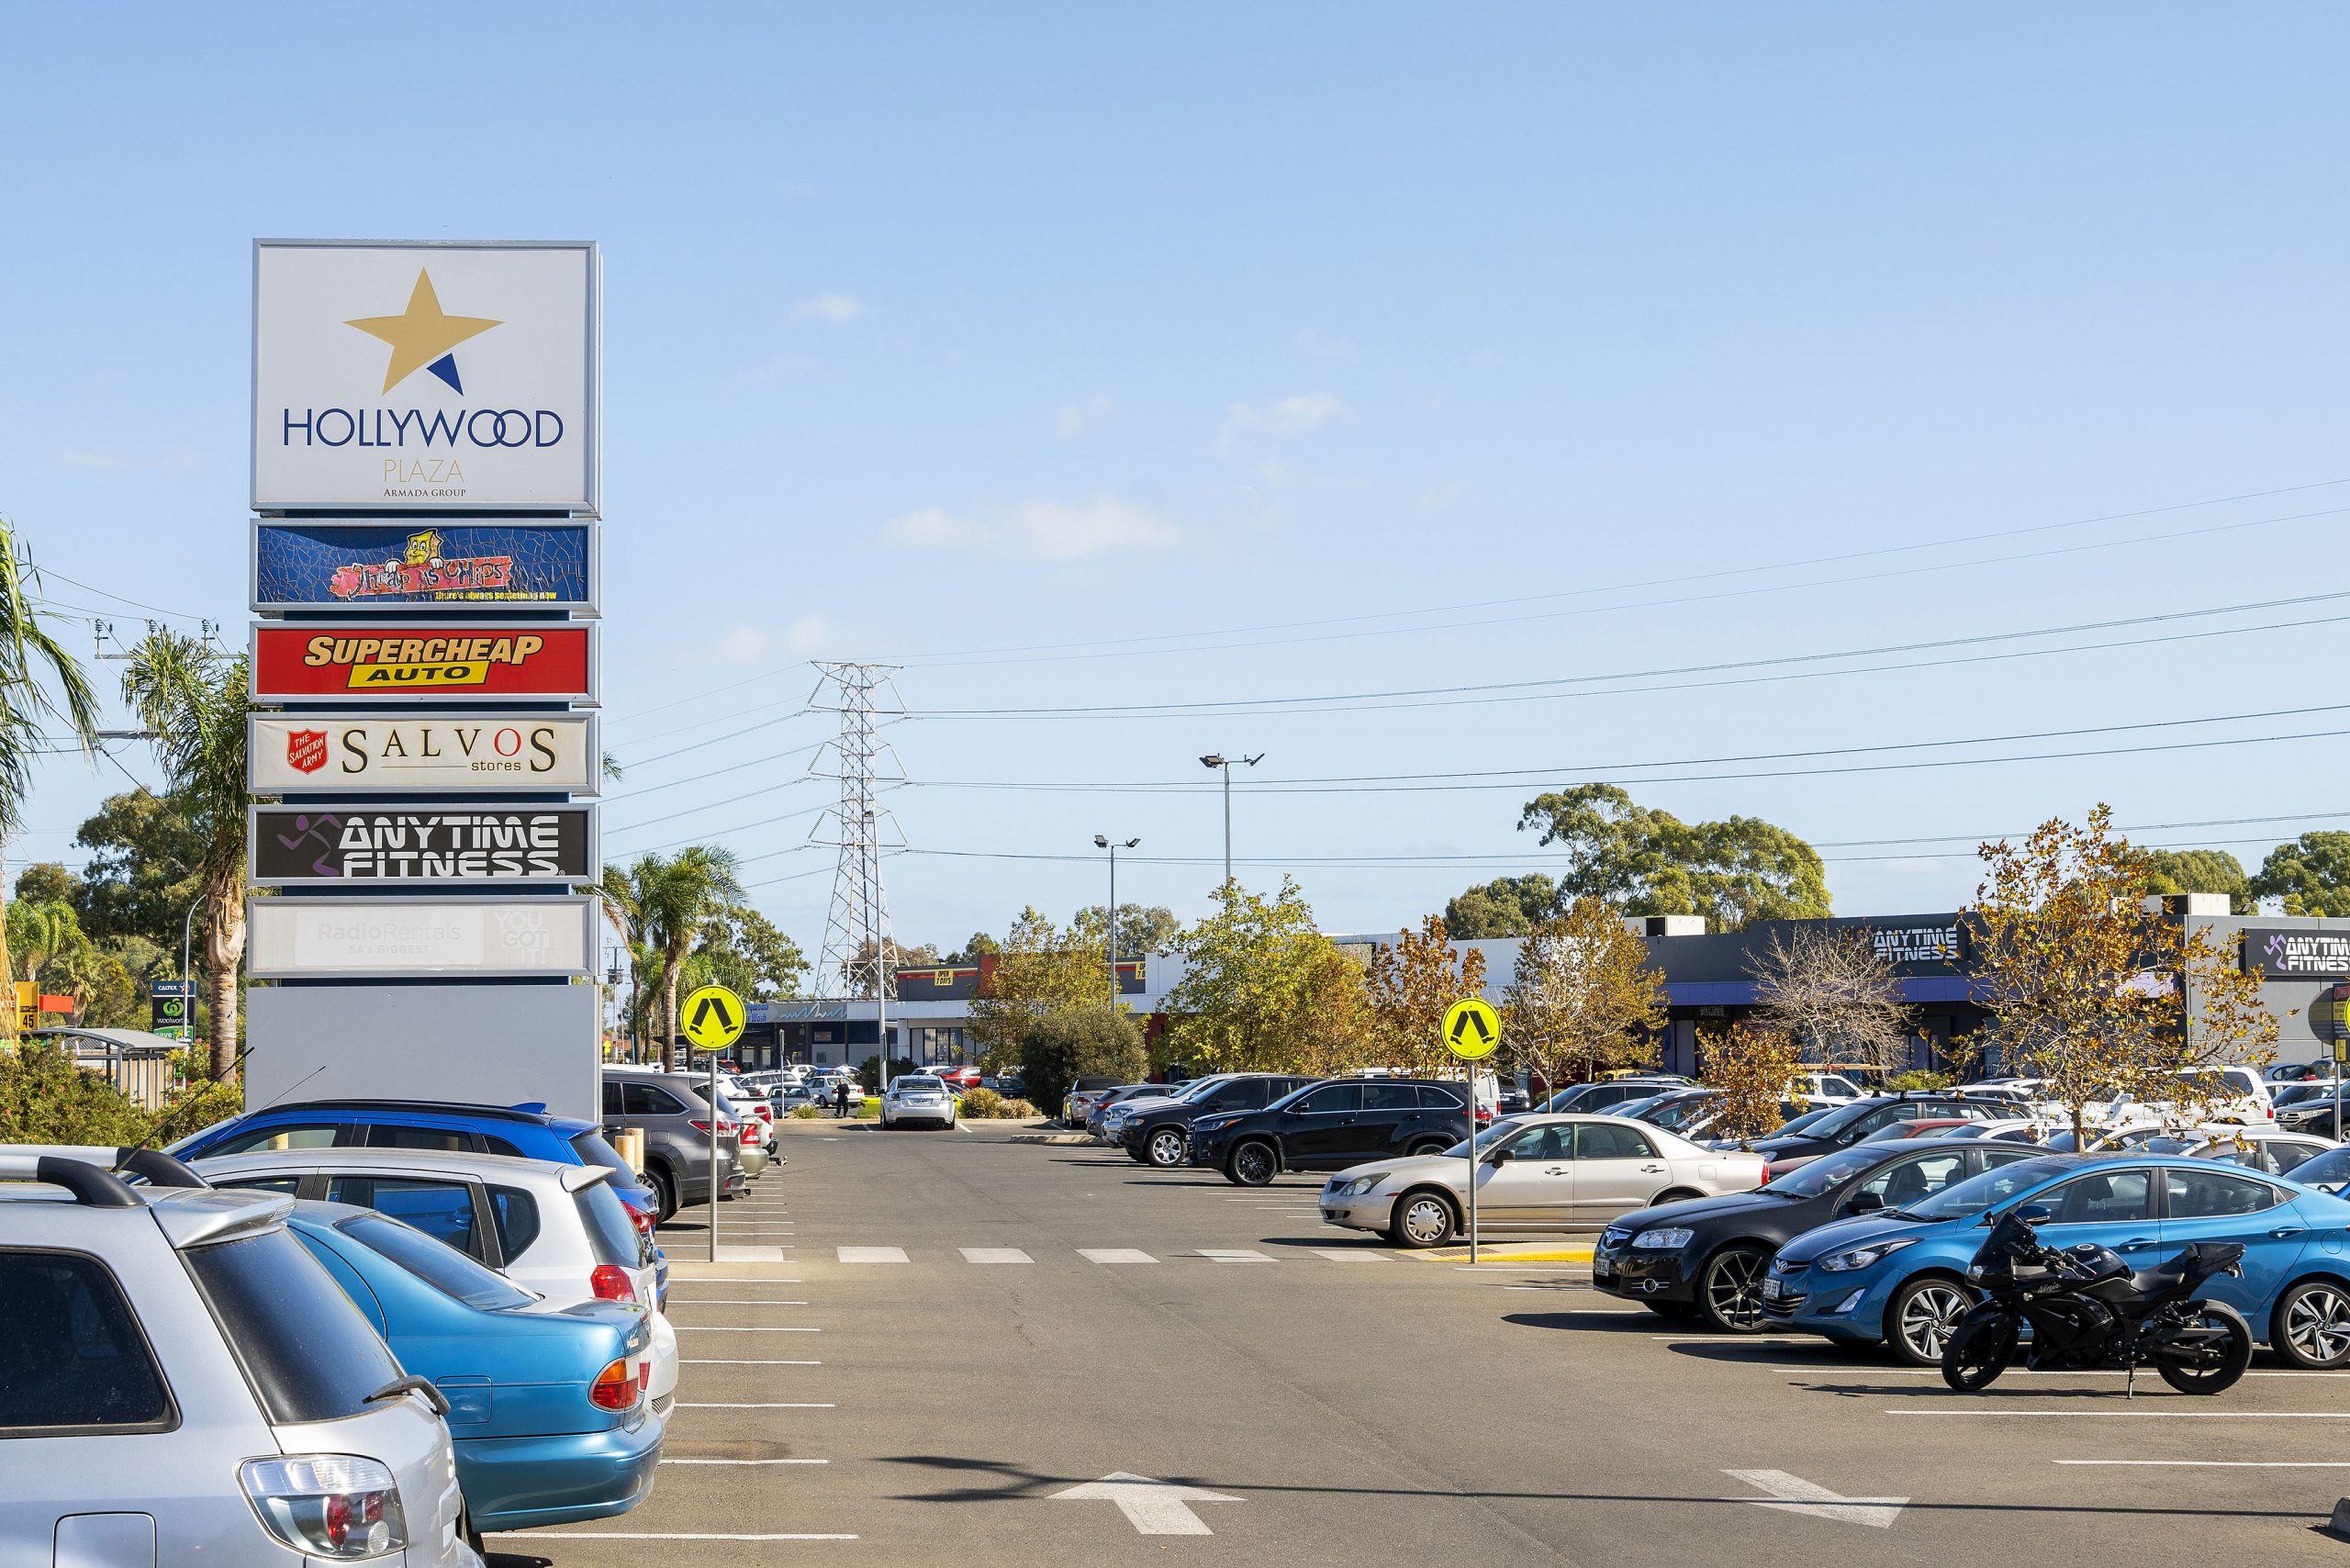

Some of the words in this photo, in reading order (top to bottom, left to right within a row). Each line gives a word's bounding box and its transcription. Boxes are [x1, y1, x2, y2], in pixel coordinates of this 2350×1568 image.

[283, 408, 565, 448] HOLLYWOOD
[384, 459, 464, 483] PLAZA
[384, 488, 429, 497] ARMADA
[431, 488, 466, 497] GROUP
[465, 590, 494, 600] always
[303, 635, 543, 666] SUPERCHEAP
[366, 666, 471, 681] AUTO
[289, 736, 324, 764] SALVATION
[295, 734, 310, 748] THE
[302, 748, 323, 768] ARMY
[341, 727, 555, 774] SALVOS
[471, 761, 521, 771] stores
[338, 815, 559, 849] ANYTIME
[342, 850, 559, 877] FITNESS
[493, 910, 543, 928] YOU
[502, 929, 549, 947] GOT
[1874, 926, 1958, 947] ANYTIME
[377, 944, 431, 954] BIGGEST
[1875, 945, 1958, 962] FITNESS
[2286, 936, 2350, 956] ANYTIM
[2287, 956, 2350, 971] FITNES
[940, 977, 952, 985] DAYS
[22, 1014, 35, 1028] 45
